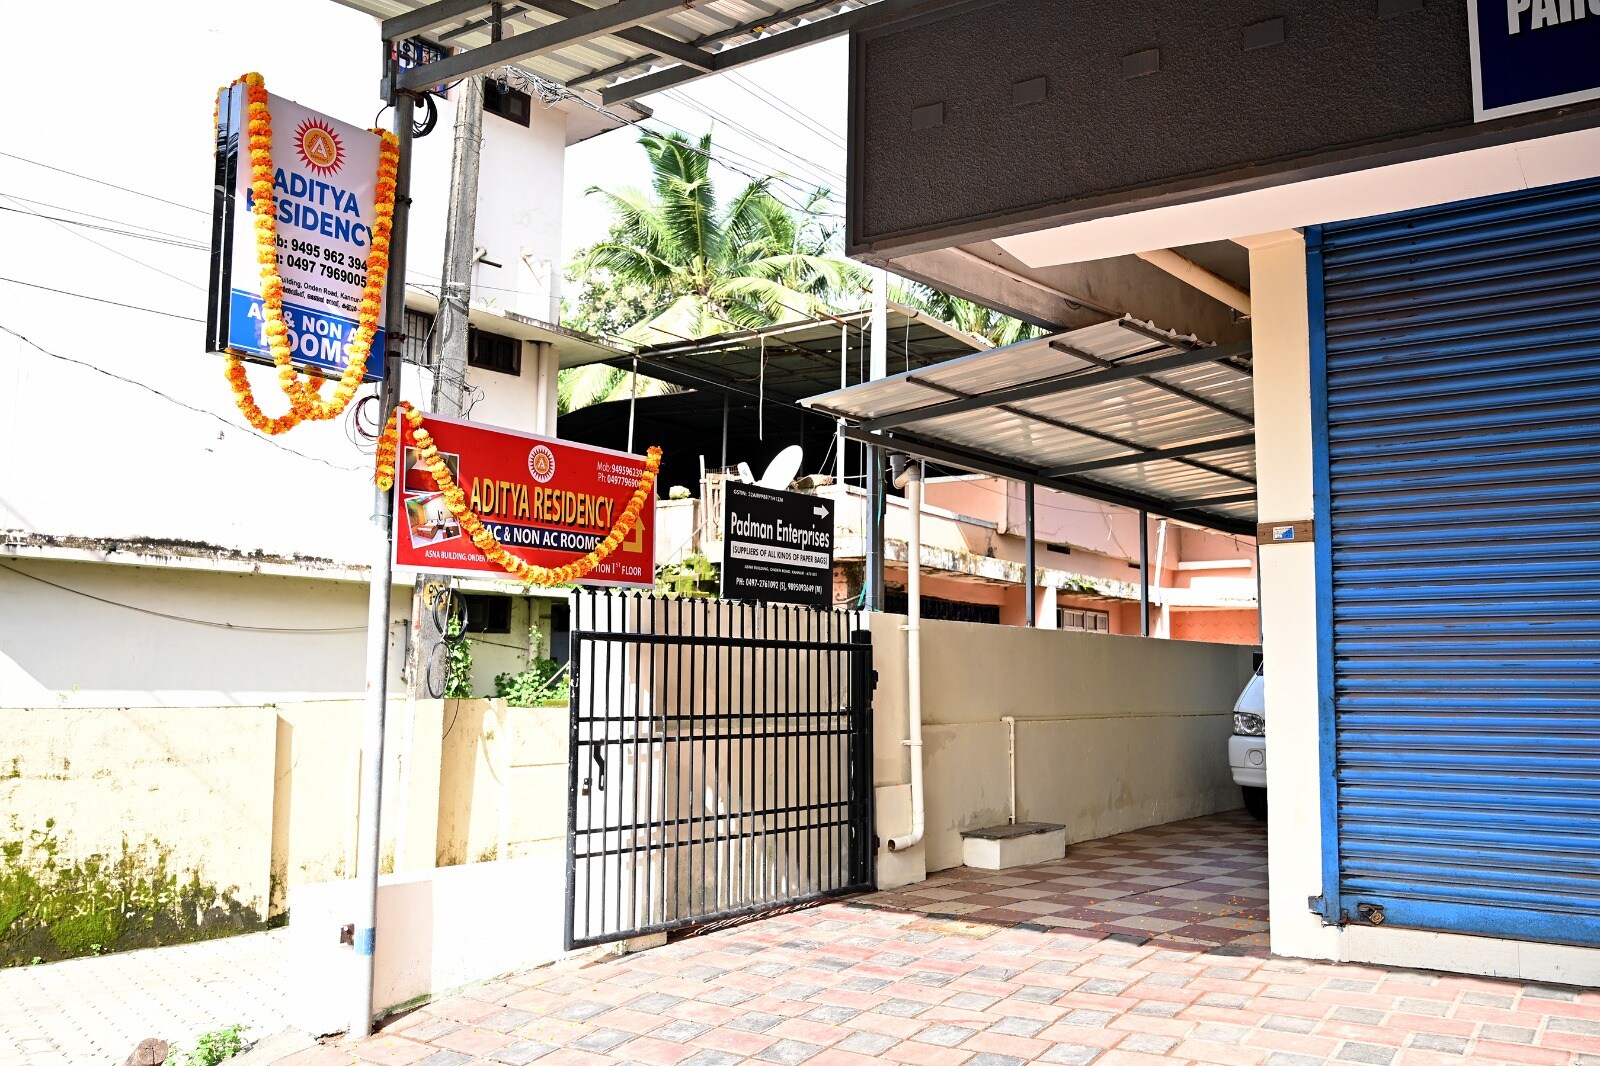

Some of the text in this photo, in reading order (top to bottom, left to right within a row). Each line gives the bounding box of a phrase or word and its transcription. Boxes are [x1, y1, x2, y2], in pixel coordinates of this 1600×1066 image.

[272, 168, 360, 217] ADITYA
[291, 239, 320, 258] 9495
[324, 249, 345, 265] 962
[348, 256, 368, 272] 394
[287, 254, 316, 273] 0497
[320, 264, 367, 288] 7969005
[283, 311, 296, 328] &
[302, 315, 342, 339] NON
[470, 476, 614, 528] ADITYA RESIDENCY
[503, 526, 511, 542] &
[513, 527, 540, 546] NON
[542, 531, 558, 547] AC
[731, 511, 830, 551] Padman Enterprises
[425, 549, 441, 559] ASNA
[441, 551, 468, 562] BUILDING,
[621, 565, 642, 576] FLOOR
[760, 549, 767, 557] OF
[768, 550, 776, 558] ALL
[777, 551, 792, 560] KINDS
[793, 553, 800, 561] OF
[800, 554, 814, 563] PAPER
